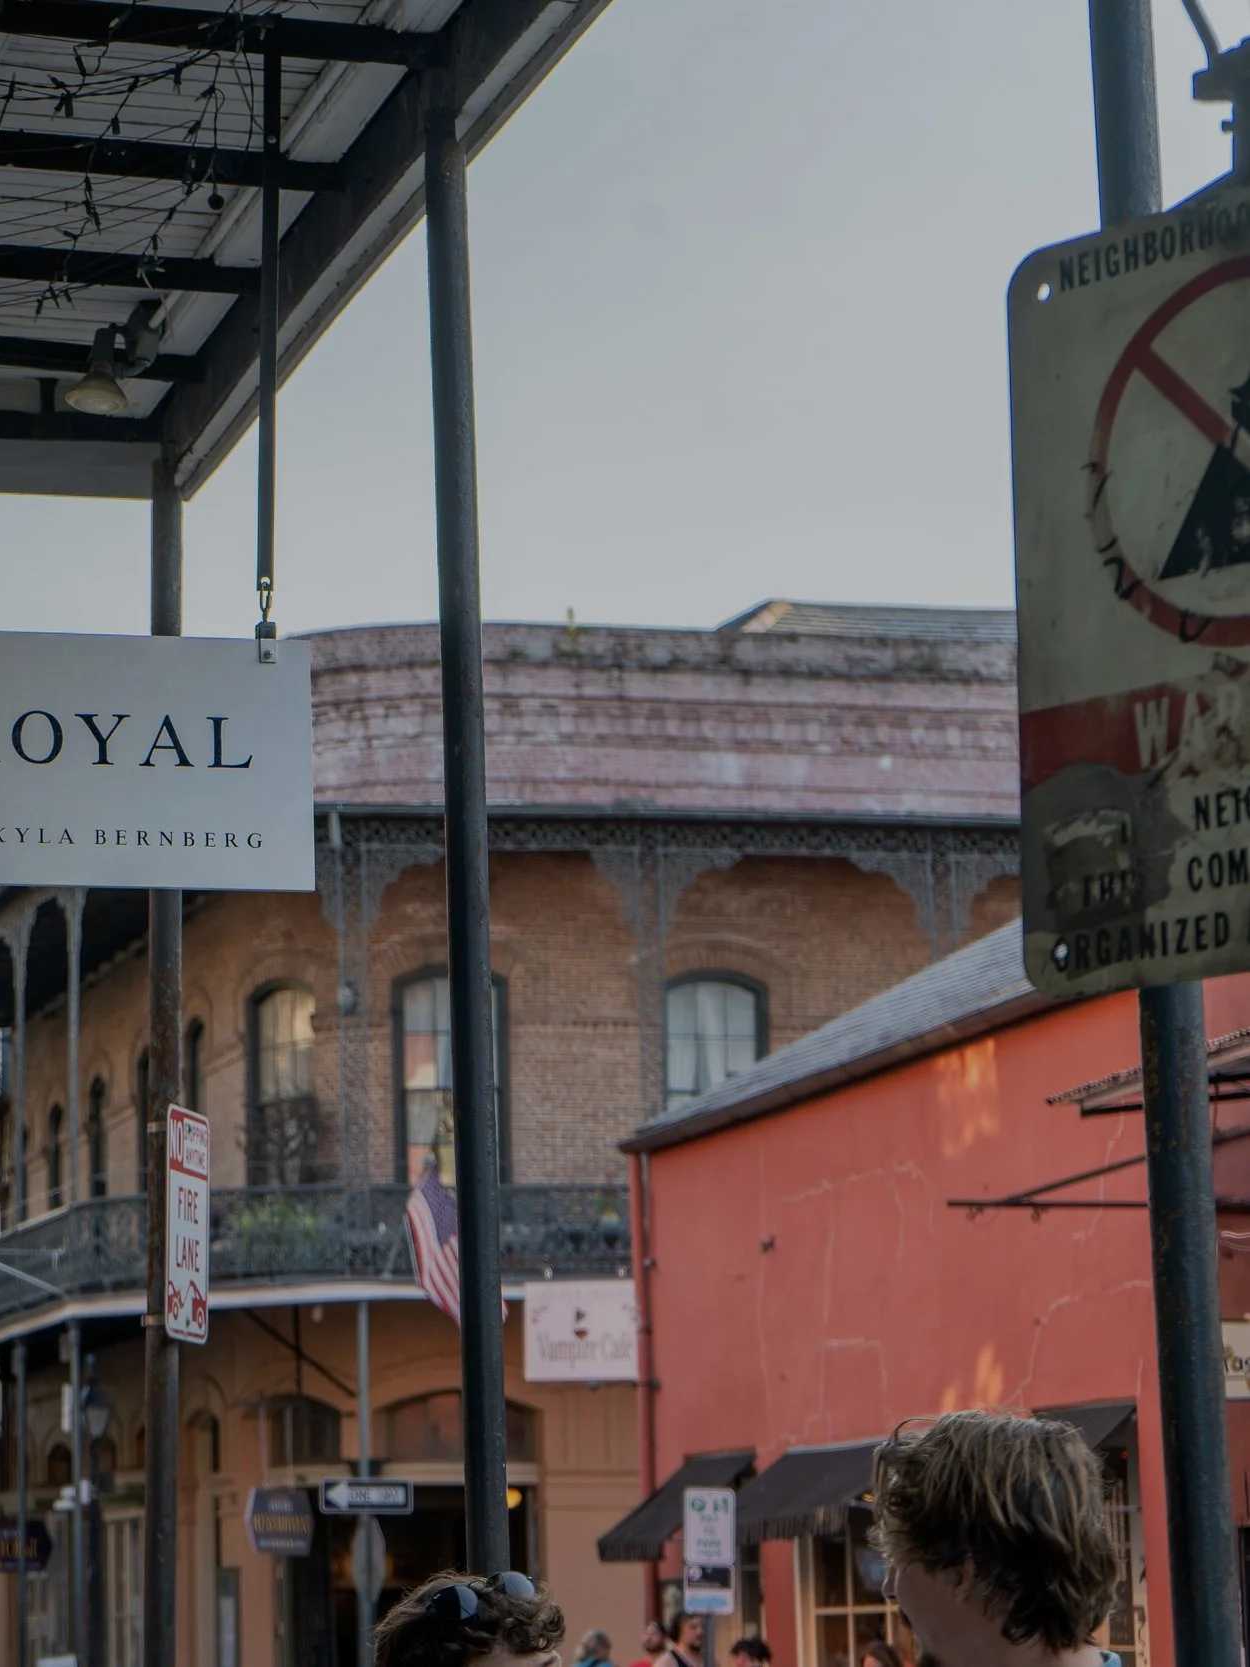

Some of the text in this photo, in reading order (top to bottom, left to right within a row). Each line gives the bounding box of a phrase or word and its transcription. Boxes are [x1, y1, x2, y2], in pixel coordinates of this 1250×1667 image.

[94, 829, 264, 849] BERNBERG
[1050, 911, 1230, 972] ORGANIZED
[170, 1118, 183, 1162] NO
[185, 1147, 206, 1169] ANYTIME
[178, 1186, 199, 1225] FIRE
[175, 1233, 200, 1273] LANE
[350, 1486, 371, 1502] ONE
